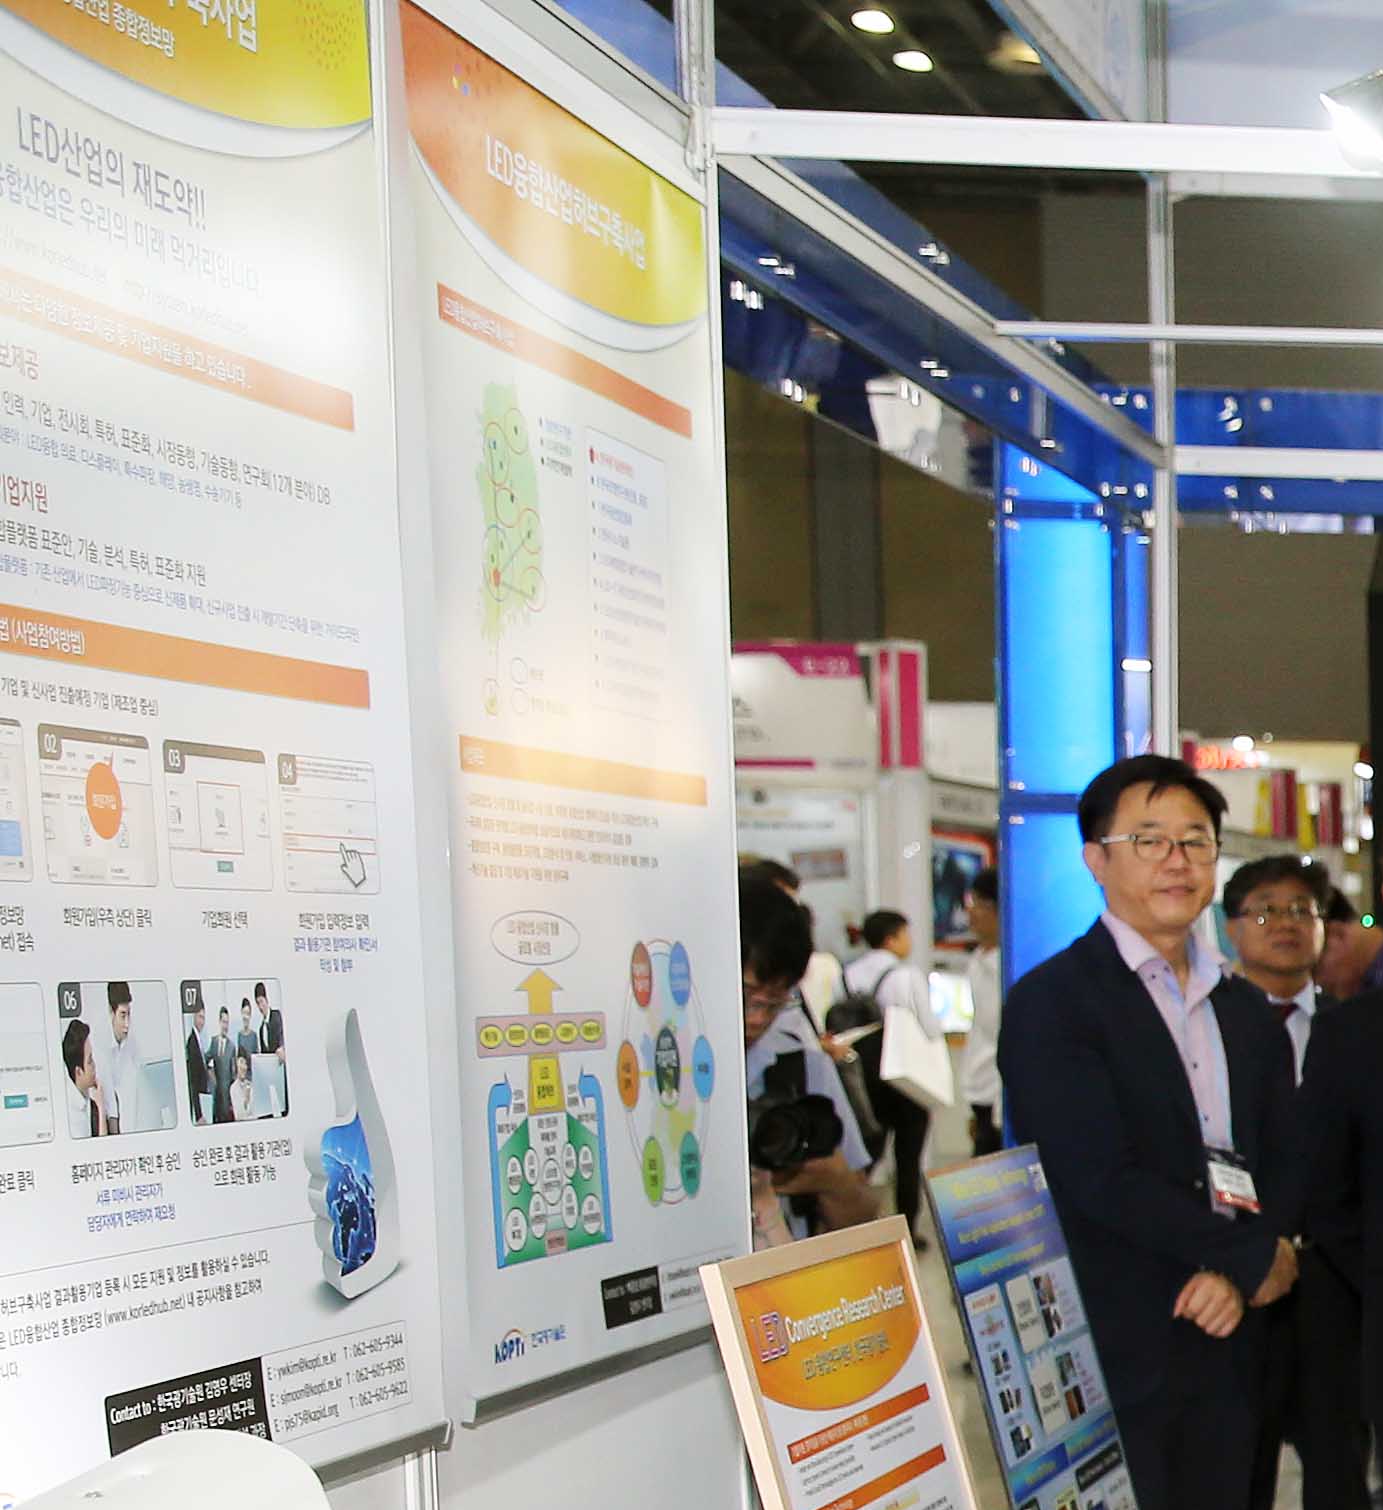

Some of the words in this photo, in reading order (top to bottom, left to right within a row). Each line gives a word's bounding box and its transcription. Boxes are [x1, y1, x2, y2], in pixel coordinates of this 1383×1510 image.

[112, 1, 176, 58] 종합정보망
[16, 107, 127, 199] LED산업의
[132, 160, 207, 232] 재도약!!
[0, 163, 74, 227] 합산업은
[79, 197, 129, 245] 우리의
[134, 222, 166, 264] 미래
[43, 733, 58, 754] 02
[168, 749, 182, 769] 03
[280, 762, 293, 780] 04
[63, 990, 77, 1010] 06
[185, 987, 198, 1007] 07
[784, 1304, 843, 1343] Convergence
[111, 1402, 142, 1424] Contact
